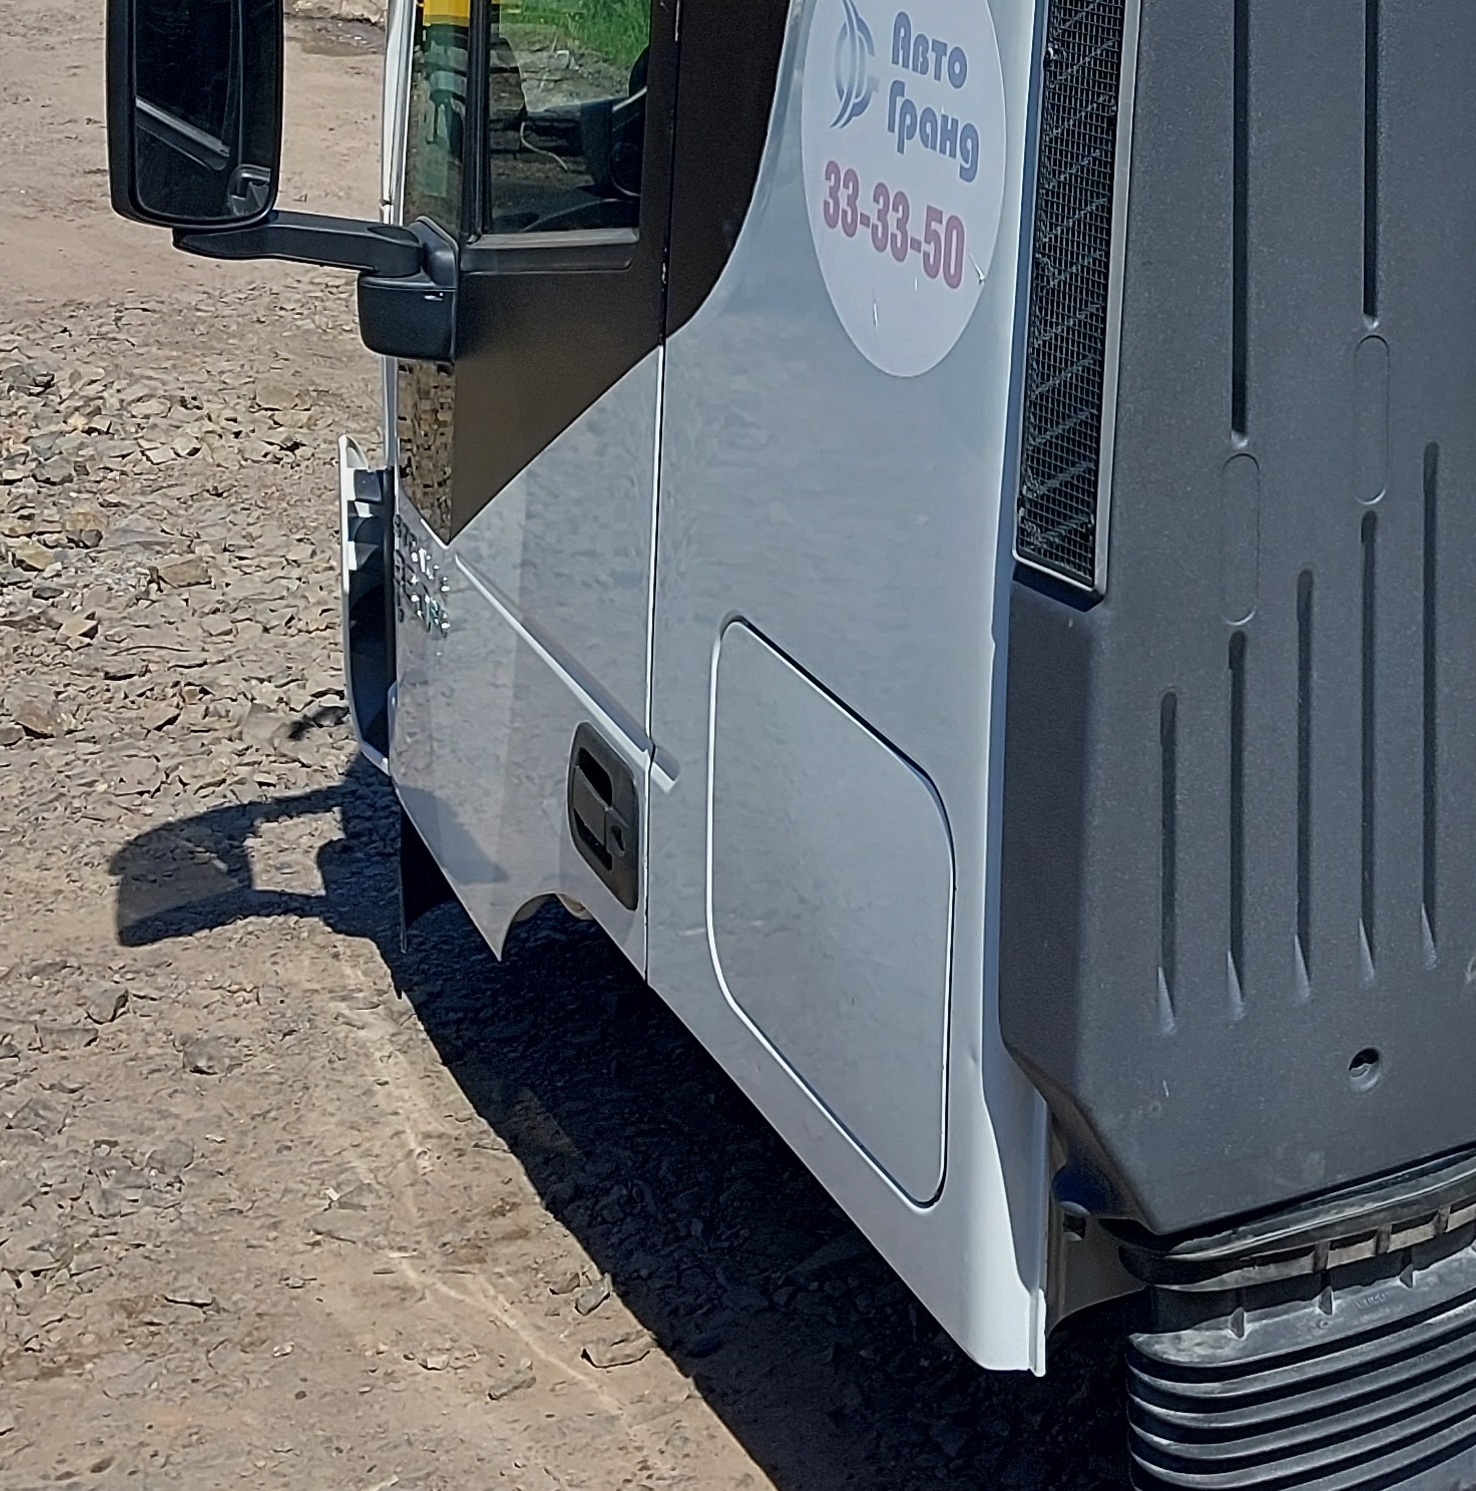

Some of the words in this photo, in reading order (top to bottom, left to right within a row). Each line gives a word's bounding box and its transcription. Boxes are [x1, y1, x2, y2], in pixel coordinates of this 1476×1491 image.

[892, 11, 968, 88] Авто
[887, 80, 980, 183] Гранд
[823, 161, 965, 289] 33-33-50
